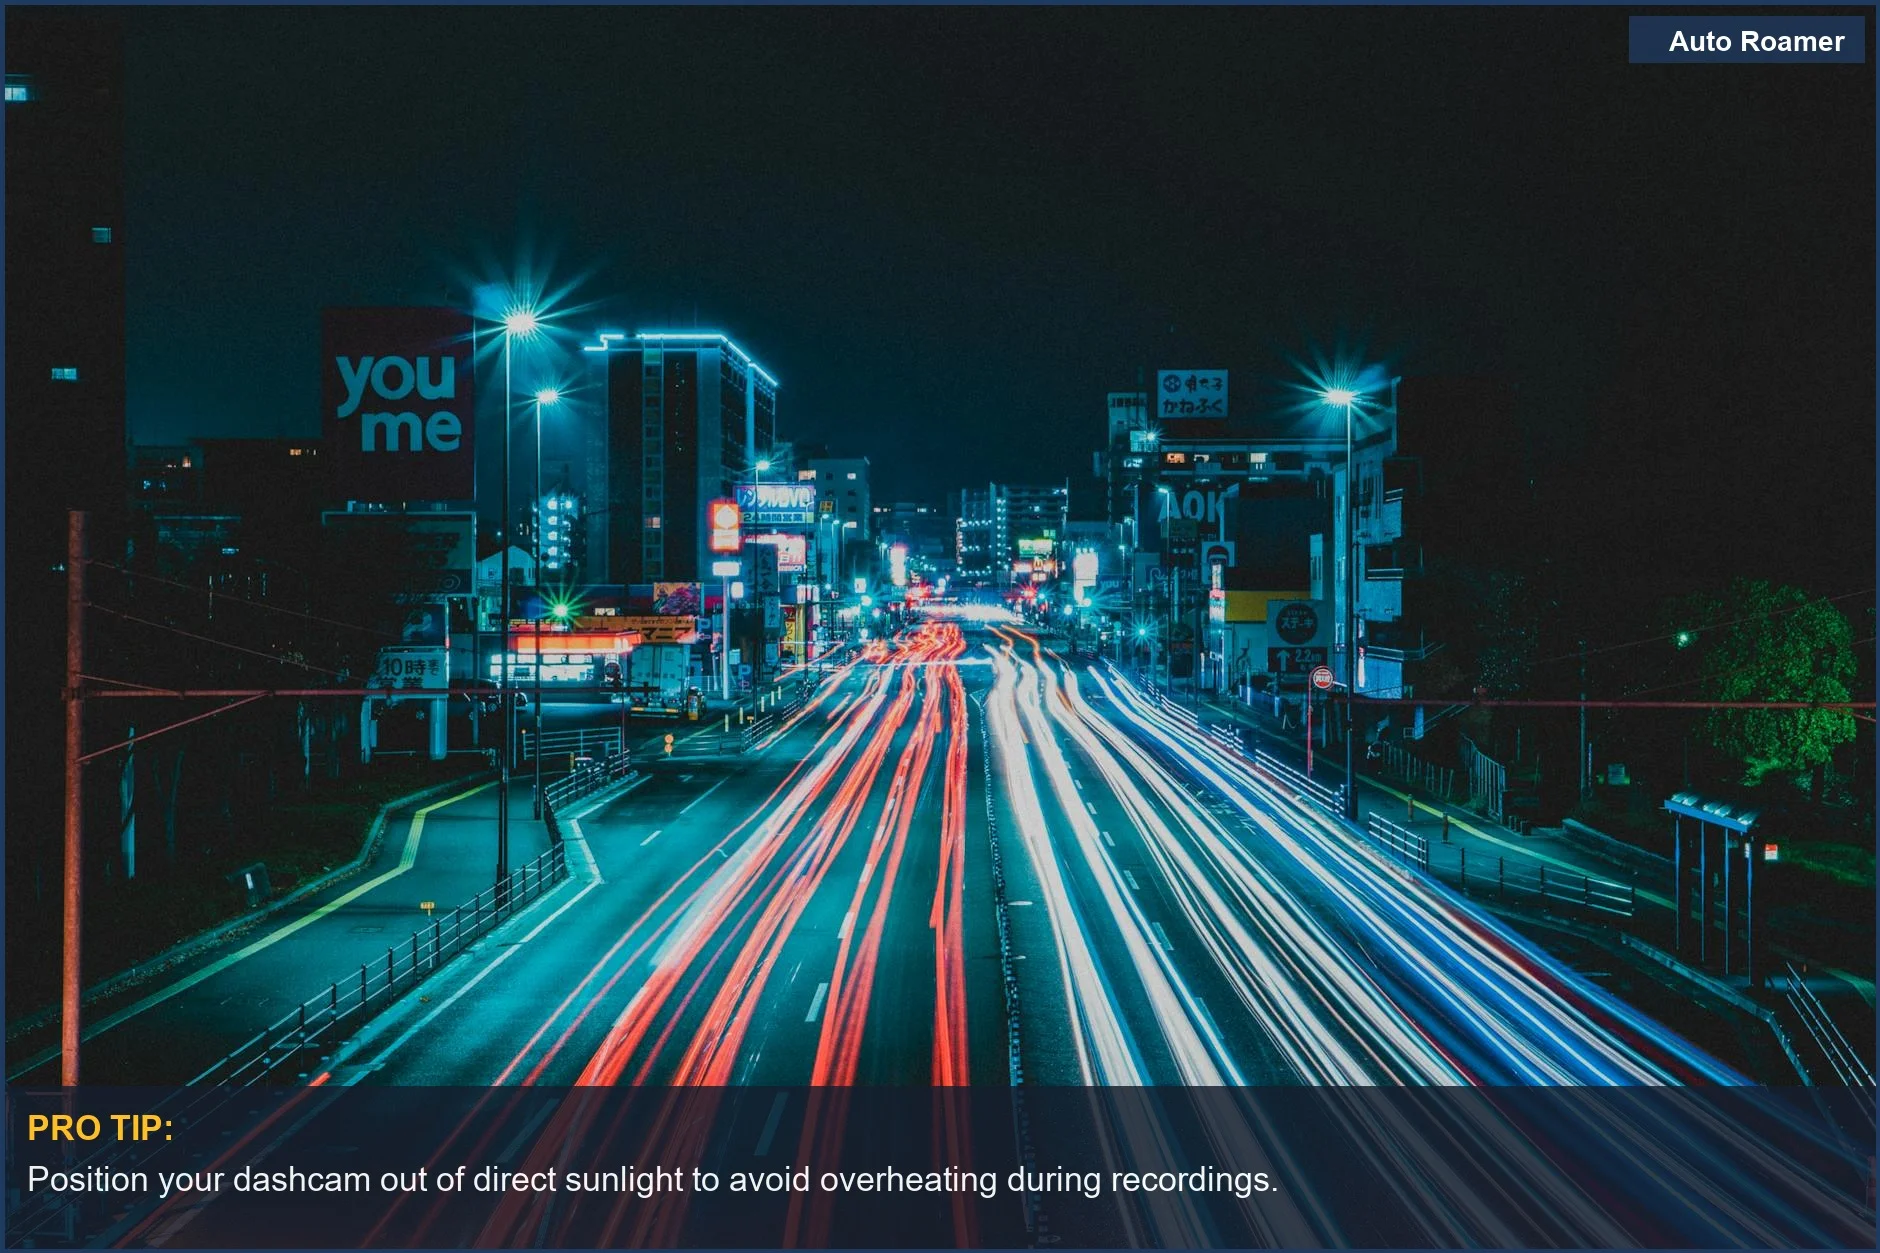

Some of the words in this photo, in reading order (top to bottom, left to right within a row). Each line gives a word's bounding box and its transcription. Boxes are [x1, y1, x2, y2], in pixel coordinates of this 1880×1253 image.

[336, 353, 455, 419] you
[1163, 397, 1224, 415] かねふく
[360, 411, 463, 453] me
